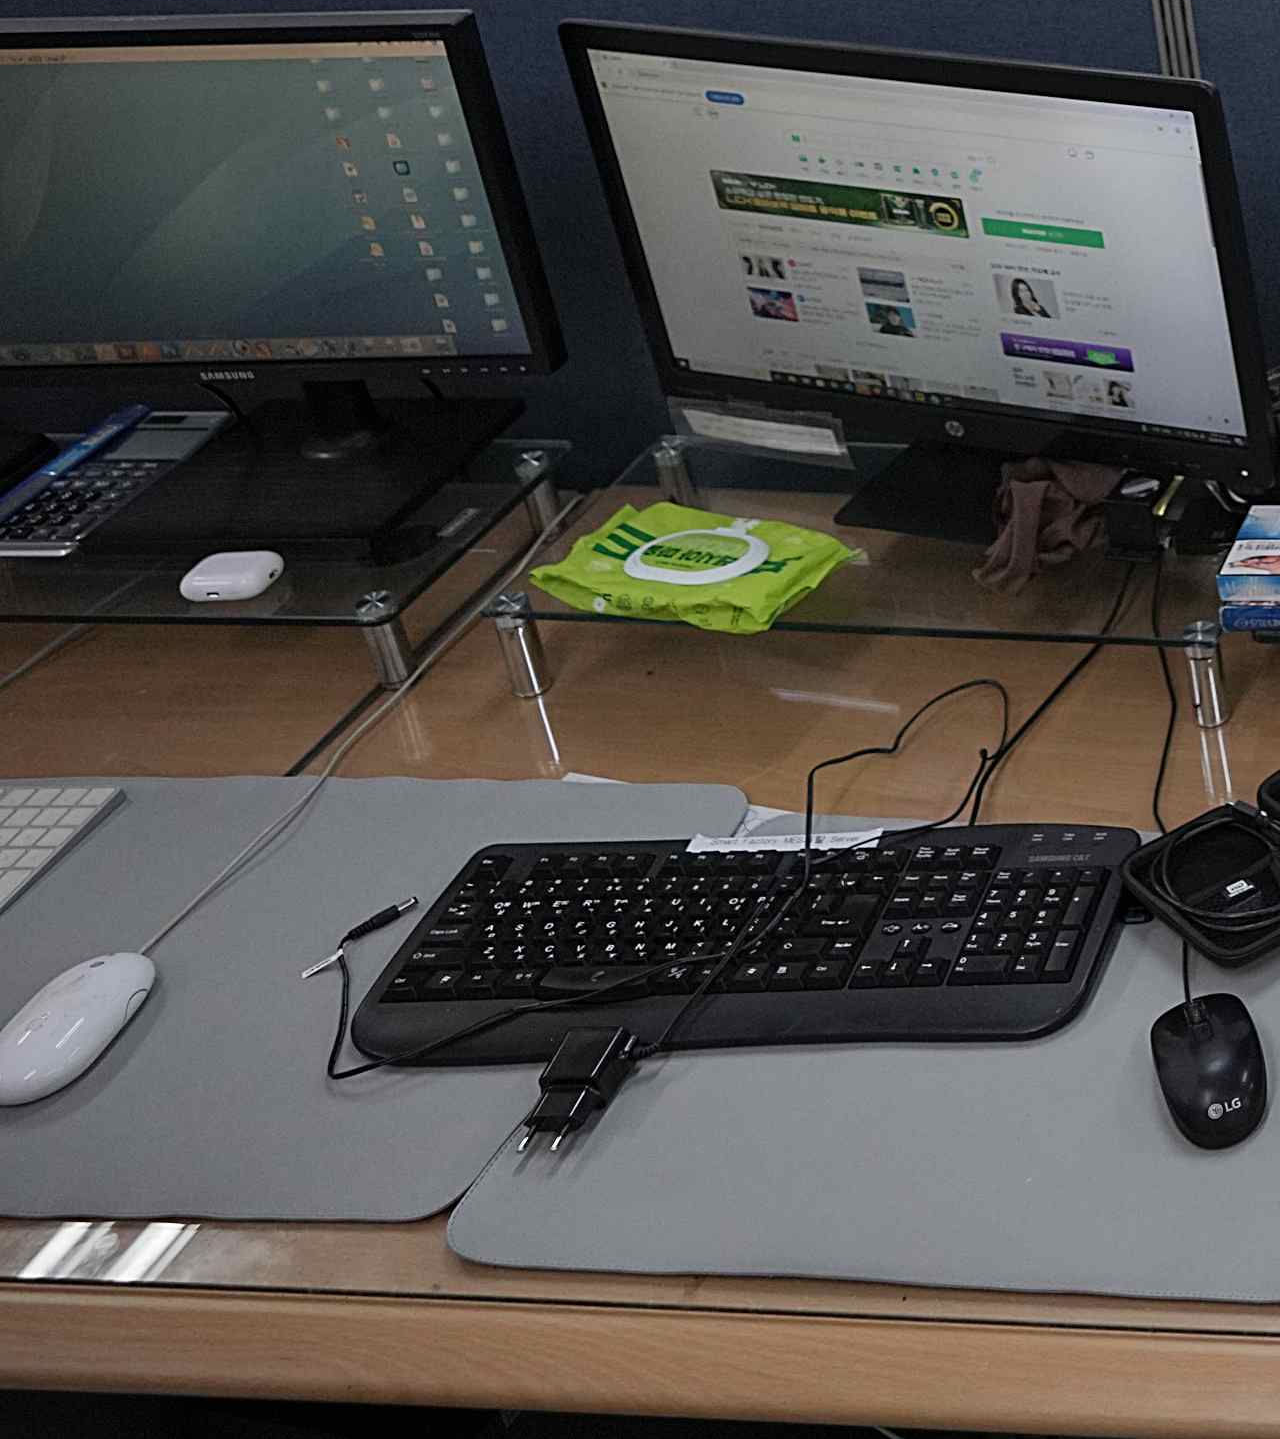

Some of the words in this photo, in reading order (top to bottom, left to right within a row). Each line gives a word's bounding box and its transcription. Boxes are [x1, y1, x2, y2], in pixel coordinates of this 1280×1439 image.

[200, 370, 255, 381] SAMSUNG
[711, 837, 737, 846] Smart
[741, 837, 777, 847] Factory
[1223, 1096, 1242, 1113] LG
